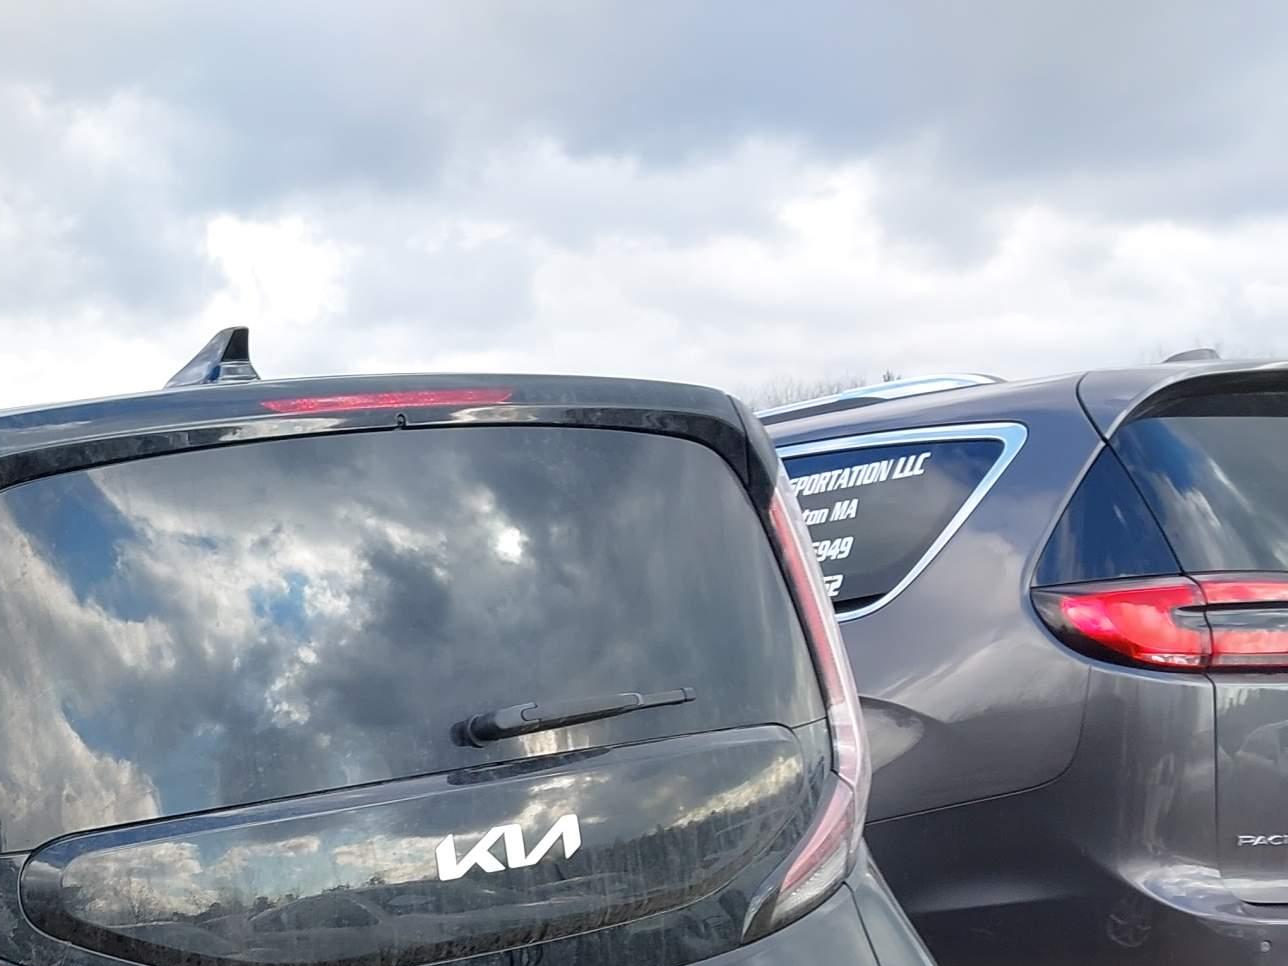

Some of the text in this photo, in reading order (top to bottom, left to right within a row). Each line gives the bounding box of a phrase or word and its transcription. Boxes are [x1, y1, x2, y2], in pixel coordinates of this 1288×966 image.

[892, 452, 931, 480] LLC
[829, 498, 859, 522] MA
[435, 813, 582, 881] KIA
